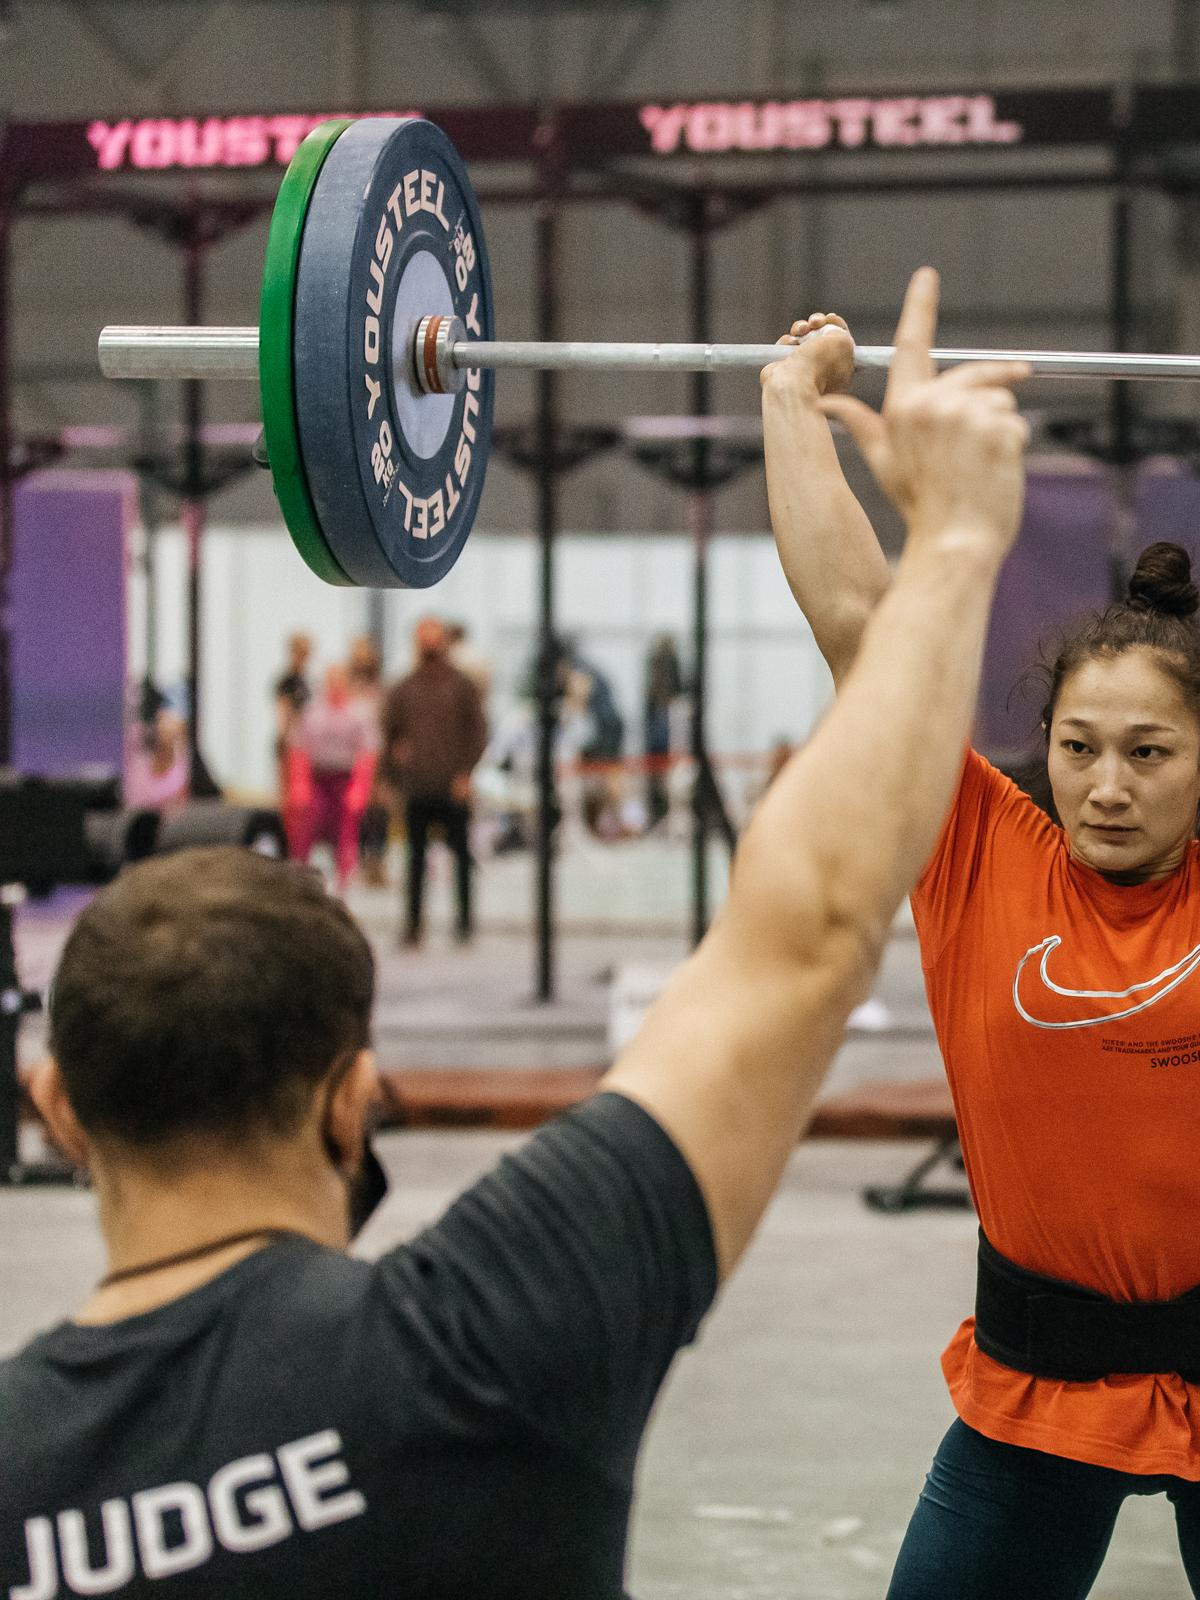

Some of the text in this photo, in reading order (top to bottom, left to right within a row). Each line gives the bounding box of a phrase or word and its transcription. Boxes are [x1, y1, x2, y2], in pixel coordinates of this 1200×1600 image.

[87, 112, 425, 170] YOUST
[640, 96, 1022, 154] YOUSTEEL
[365, 169, 449, 420] YOUSTEEL
[371, 420, 392, 485] 20
[8, 1427, 367, 1600] JUDGE
